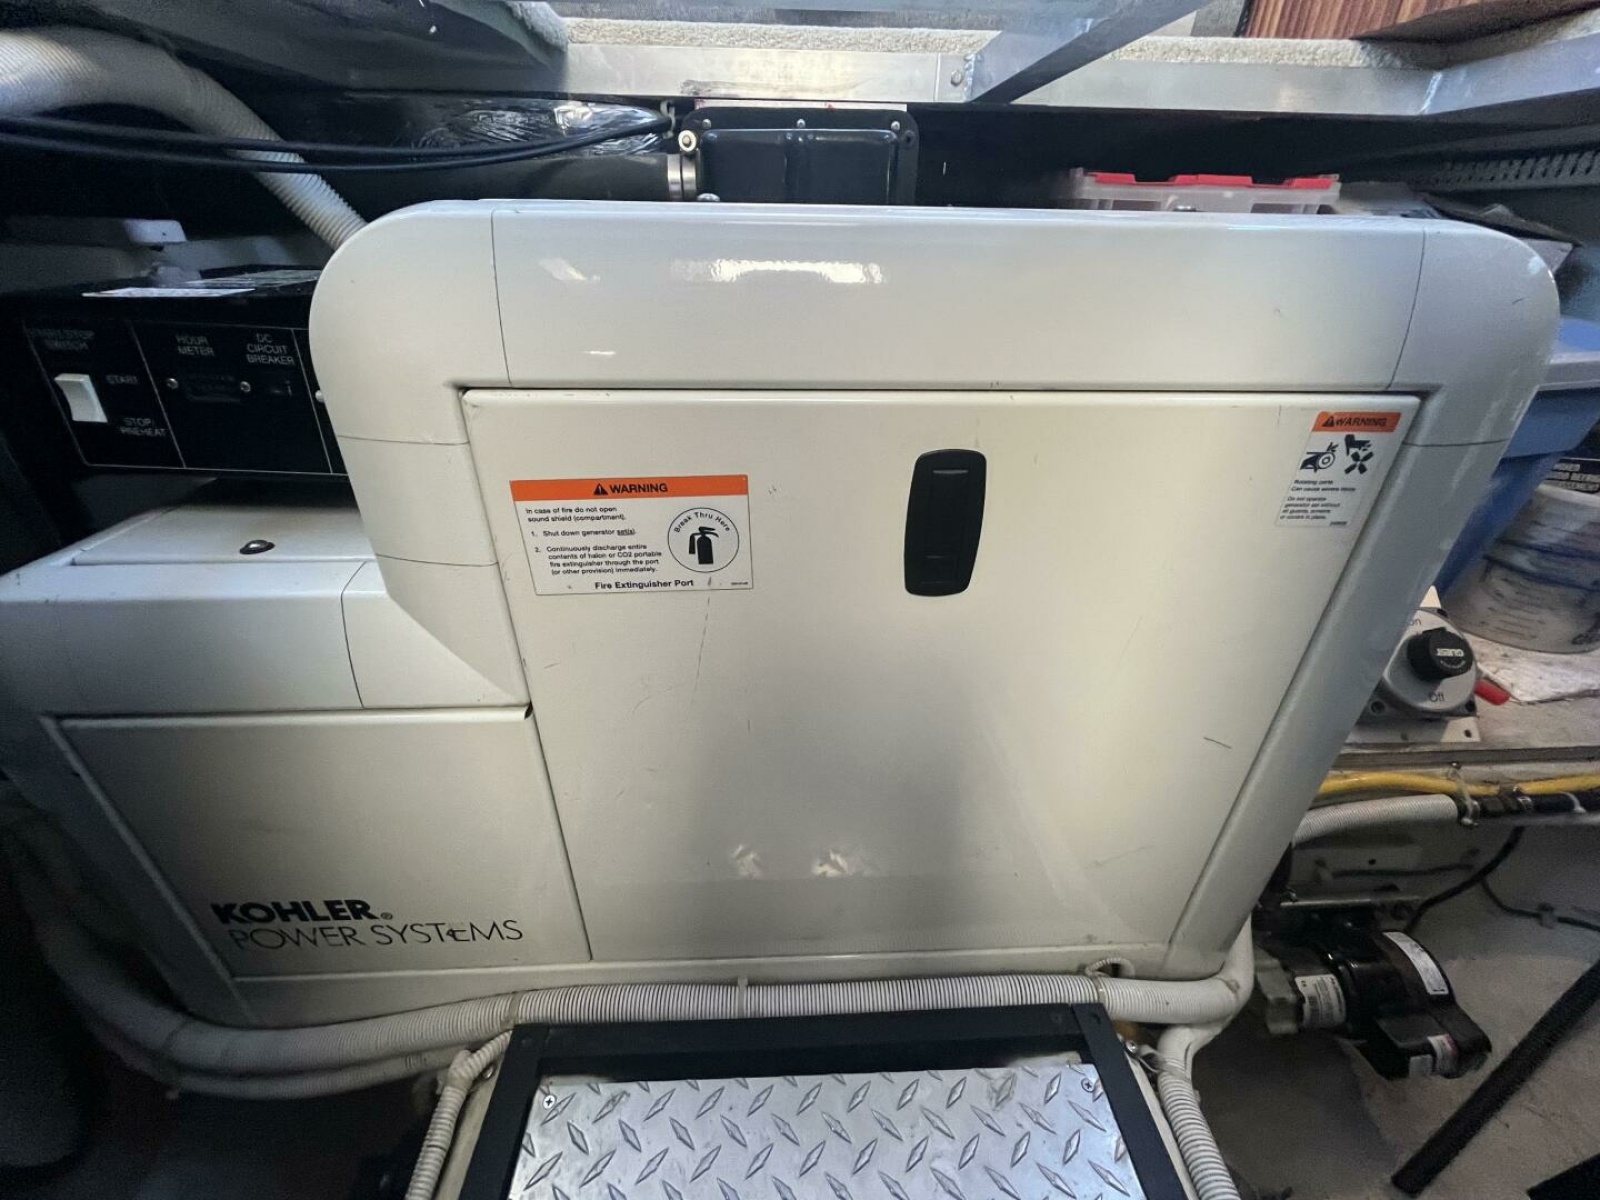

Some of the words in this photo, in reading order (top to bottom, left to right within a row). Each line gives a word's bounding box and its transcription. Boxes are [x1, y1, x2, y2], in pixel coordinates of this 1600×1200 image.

[178, 346, 215, 356] METER
[246, 343, 288, 354] CIRCUIT
[246, 354, 295, 366] BREAKER
[1335, 417, 1388, 427] WARNING
[609, 482, 668, 494] WARNING
[527, 515, 550, 523] sound
[674, 515, 692, 533] Break
[694, 512, 713, 520] Thru
[715, 516, 730, 532] Here
[581, 529, 615, 537] generator
[546, 545, 591, 553] Continuously
[592, 544, 627, 552] discharge
[579, 552, 588, 560] of
[633, 551, 662, 559] portable
[562, 560, 604, 569] extinguisher
[604, 560, 631, 568] through
[645, 559, 660, 567] port
[581, 567, 615, 575] provision)
[615, 566, 659, 574] immediately.
[594, 581, 613, 590] Fire
[614, 581, 672, 590] Extinguisher
[673, 579, 694, 587] Port
[228, 924, 367, 950] POWER
[369, 918, 524, 945] SYSTEMS
